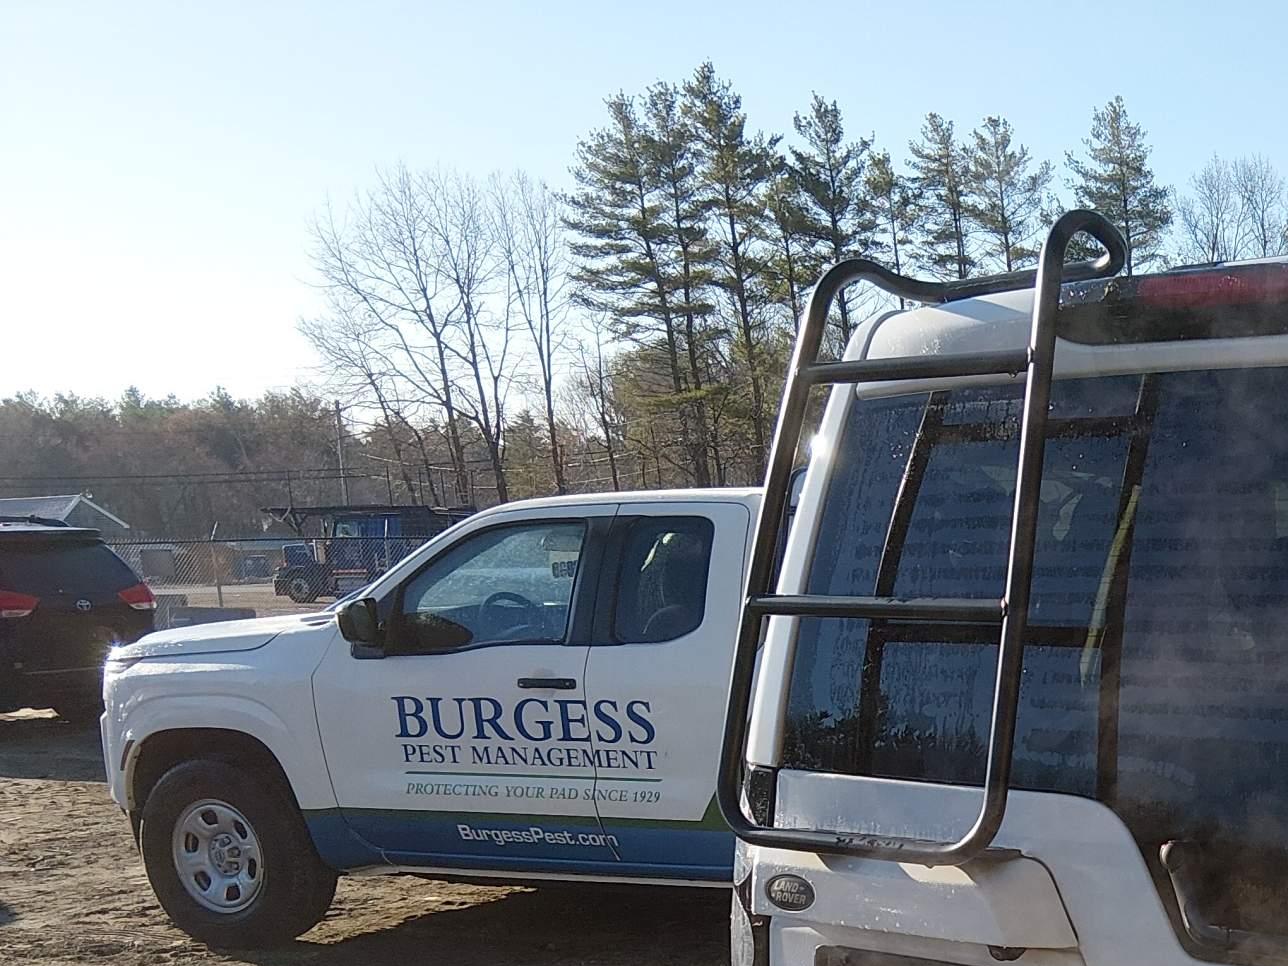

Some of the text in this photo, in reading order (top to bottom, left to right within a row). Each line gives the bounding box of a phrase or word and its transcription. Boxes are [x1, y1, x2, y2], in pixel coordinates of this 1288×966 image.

[391, 695, 657, 745] BURGESS
[401, 743, 658, 770] PEST MANAGEMENT
[405, 782, 661, 803] PROTECTING YOUR PAD SINCE 1929
[456, 824, 620, 847] BurgessPest.com
[773, 879, 799, 893] LAND
[775, 891, 806, 905] ROVER
